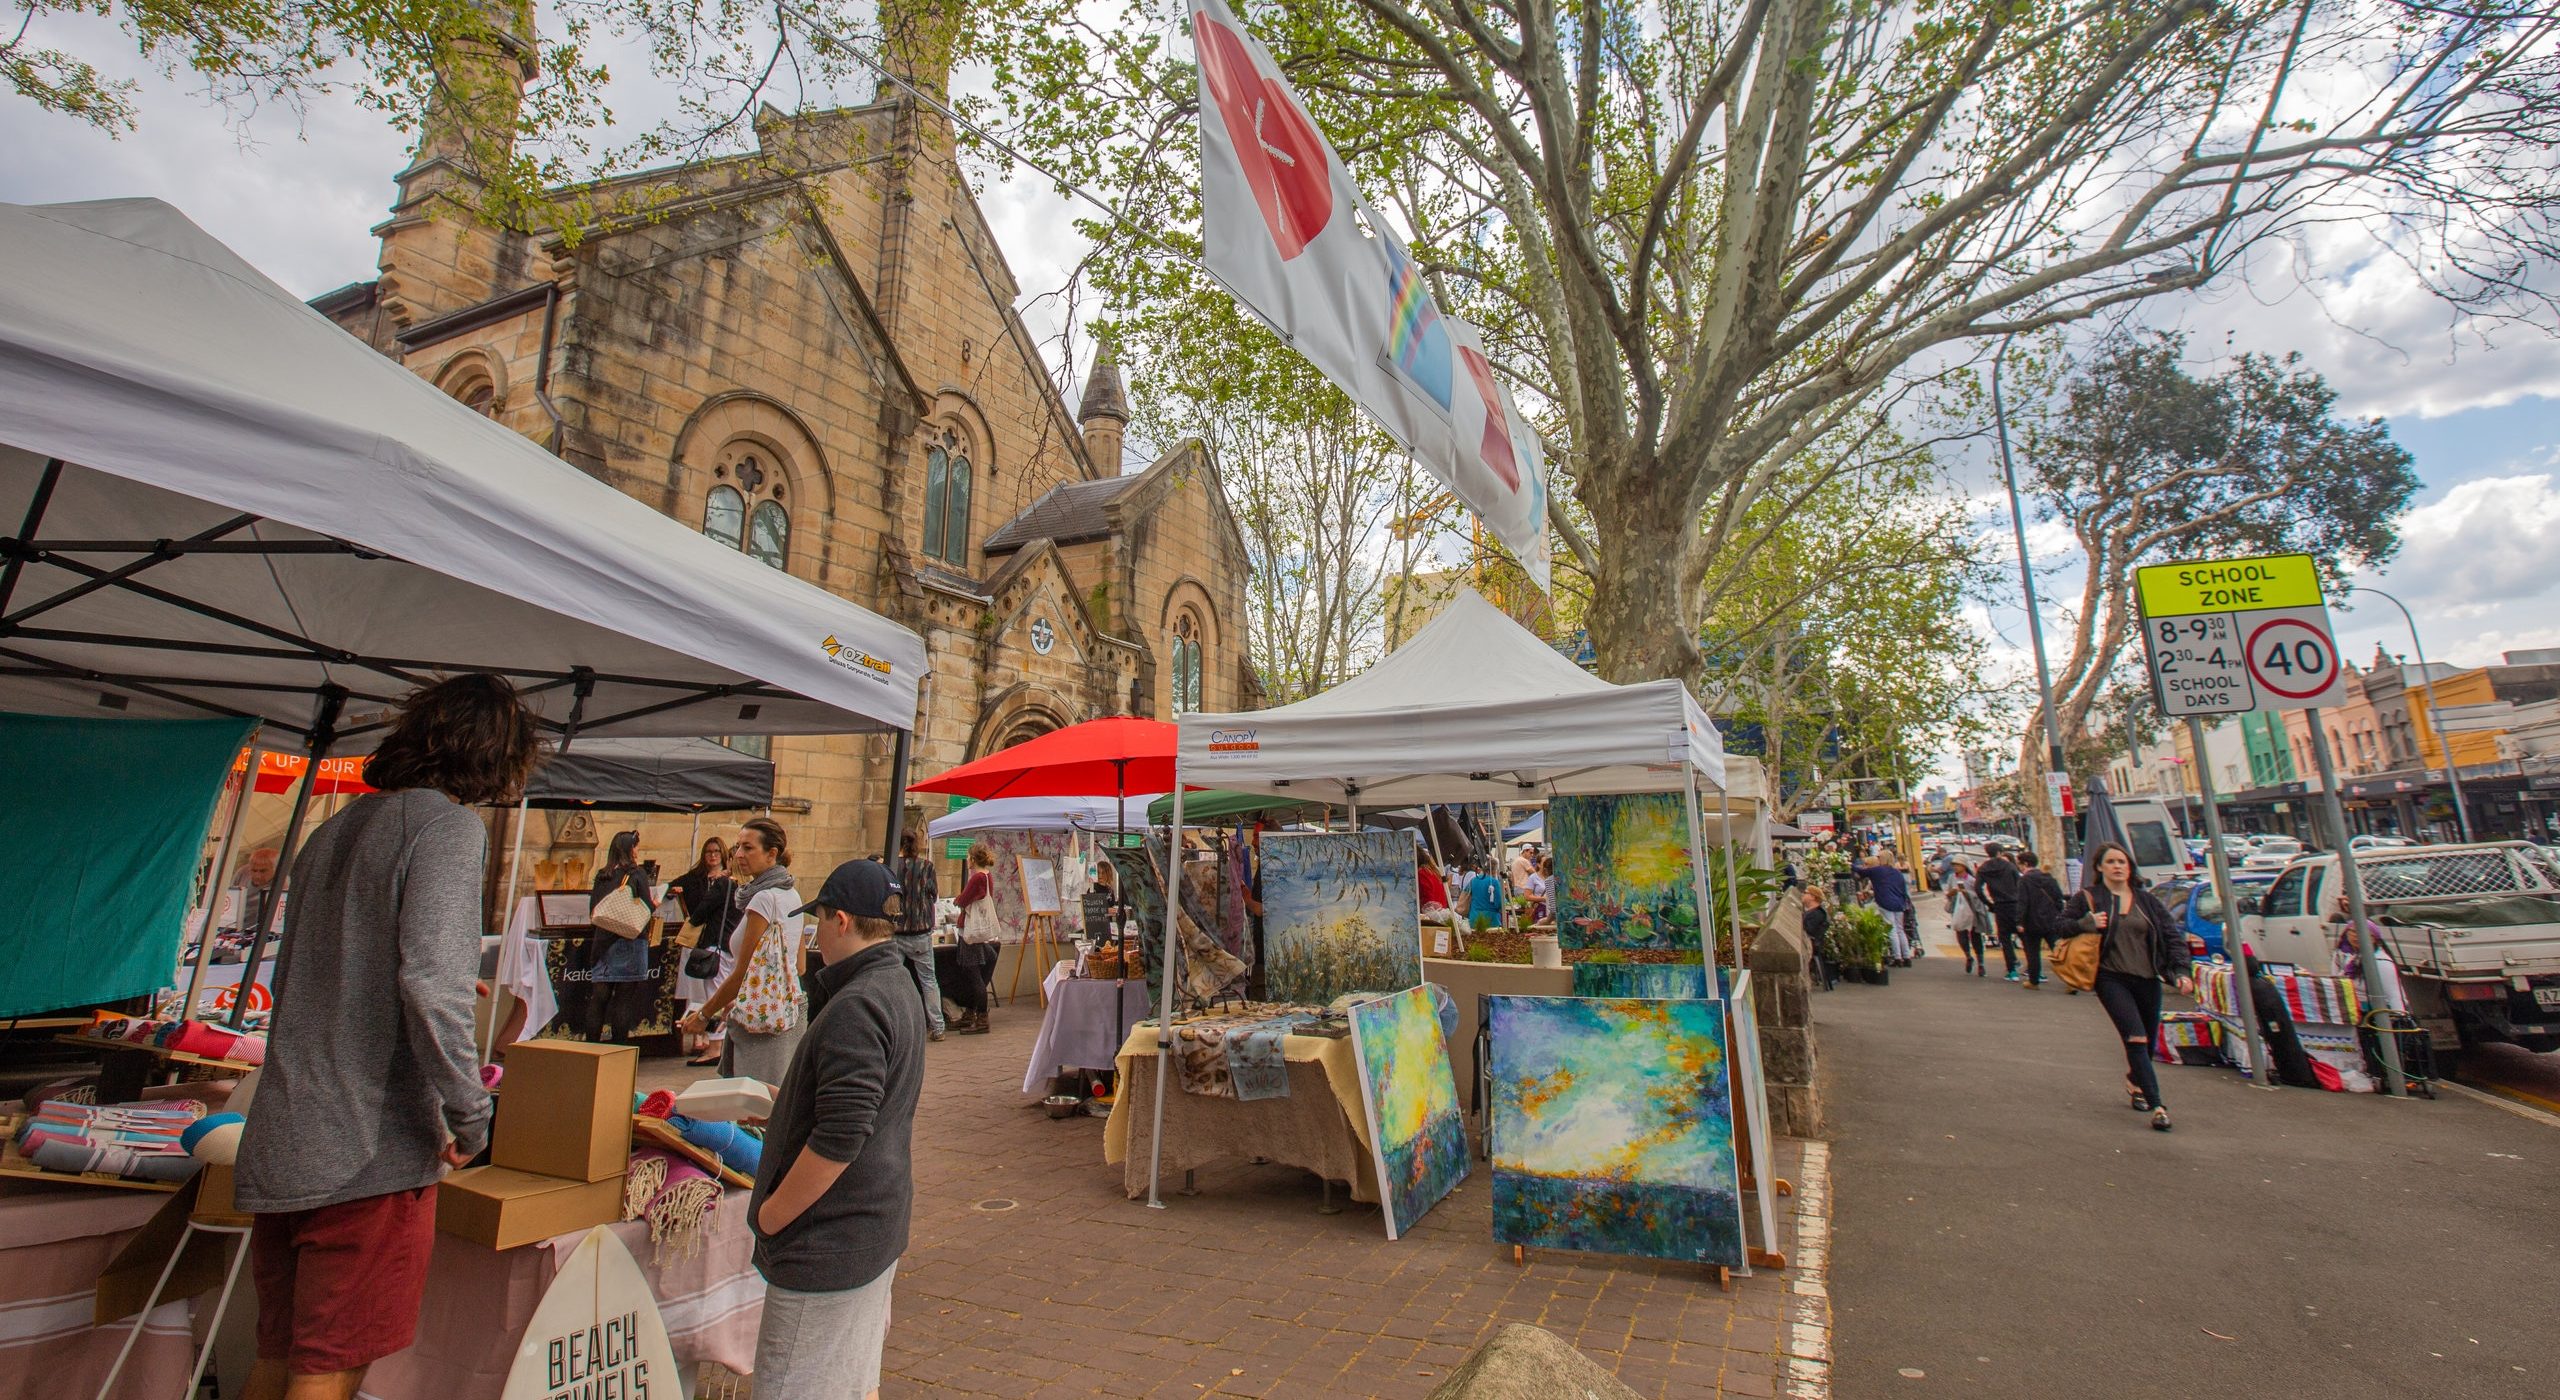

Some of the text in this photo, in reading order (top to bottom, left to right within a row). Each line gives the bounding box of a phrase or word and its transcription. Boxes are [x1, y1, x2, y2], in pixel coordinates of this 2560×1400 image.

[2179, 565, 2276, 586] SCHOOL
[2199, 587, 2263, 606] ZONE
[2264, 640, 2324, 676] 40
[2169, 676, 2240, 691] SCHOOL
[2185, 693, 2230, 707] DAYS
[276, 754, 300, 768] UP
[308, 757, 355, 774] OUR
[563, 968, 593, 981] kate
[548, 1310, 639, 1390] BEACH
